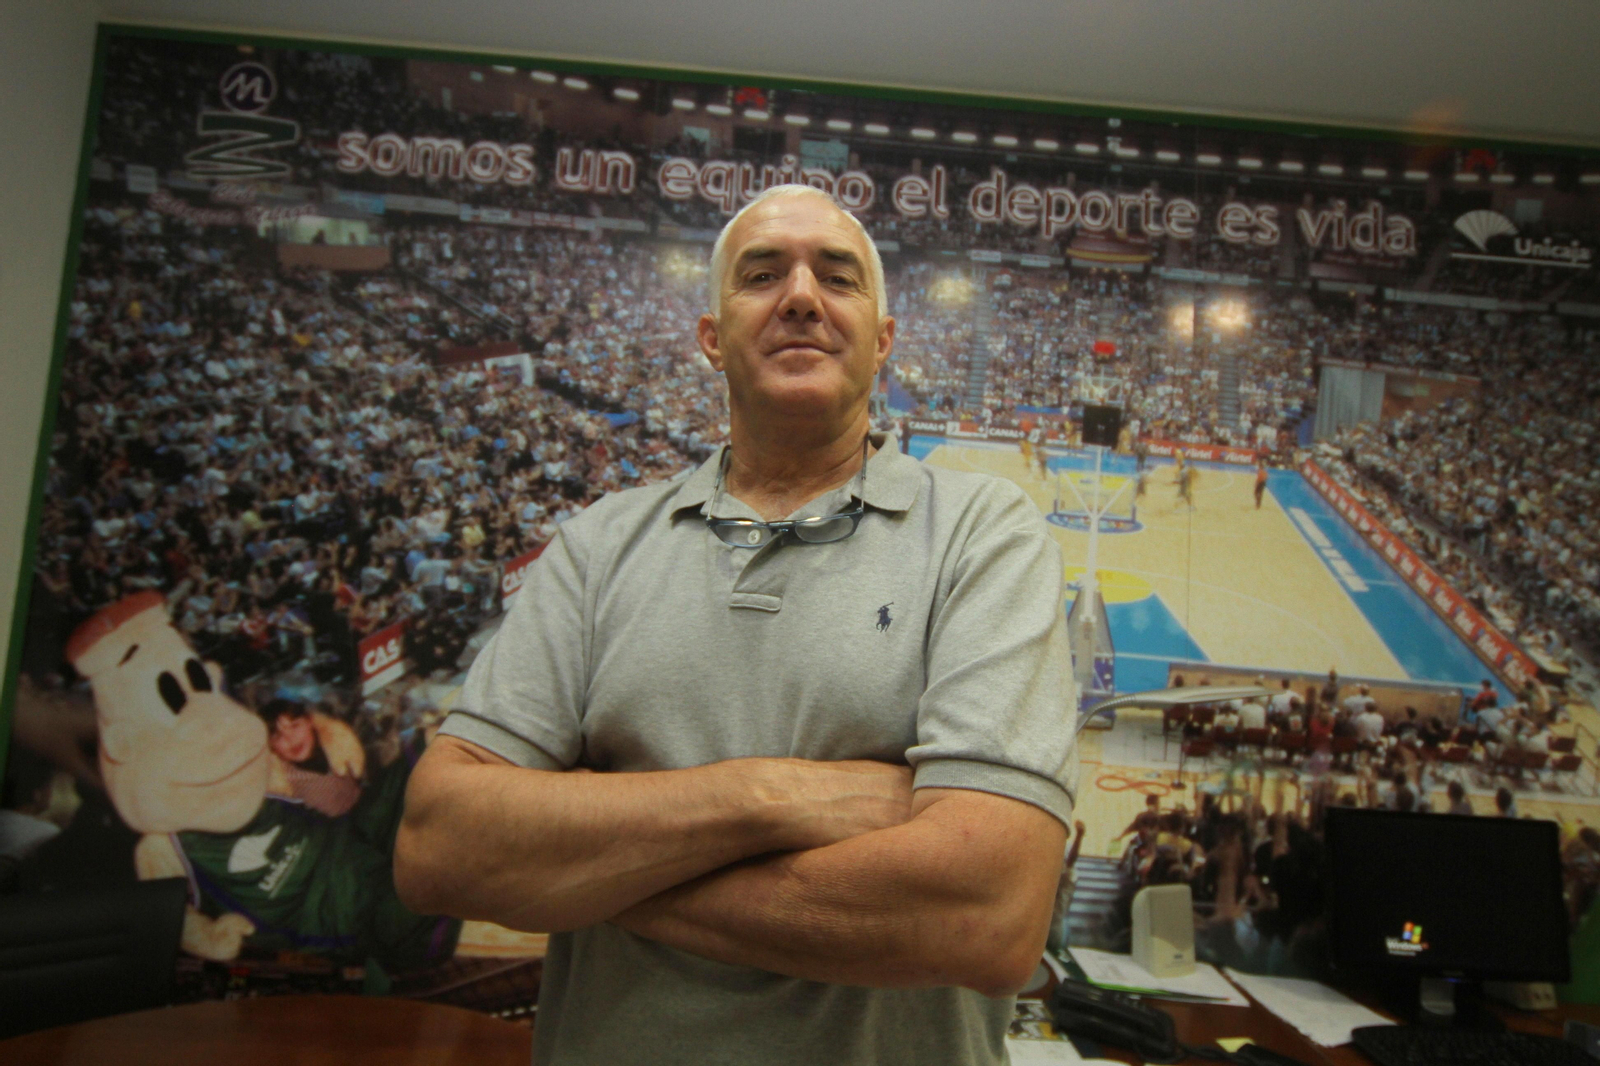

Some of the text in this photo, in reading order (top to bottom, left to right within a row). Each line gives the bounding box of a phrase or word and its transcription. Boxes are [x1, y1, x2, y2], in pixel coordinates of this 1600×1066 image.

[336, 130, 537, 186] somos
[555, 147, 636, 193] un
[892, 164, 950, 219] el
[968, 166, 1200, 240] deporte
[1216, 201, 1281, 246] es
[1297, 199, 1418, 257] vida
[1514, 236, 1592, 264] Unicaja
[362, 638, 401, 674] CAS
